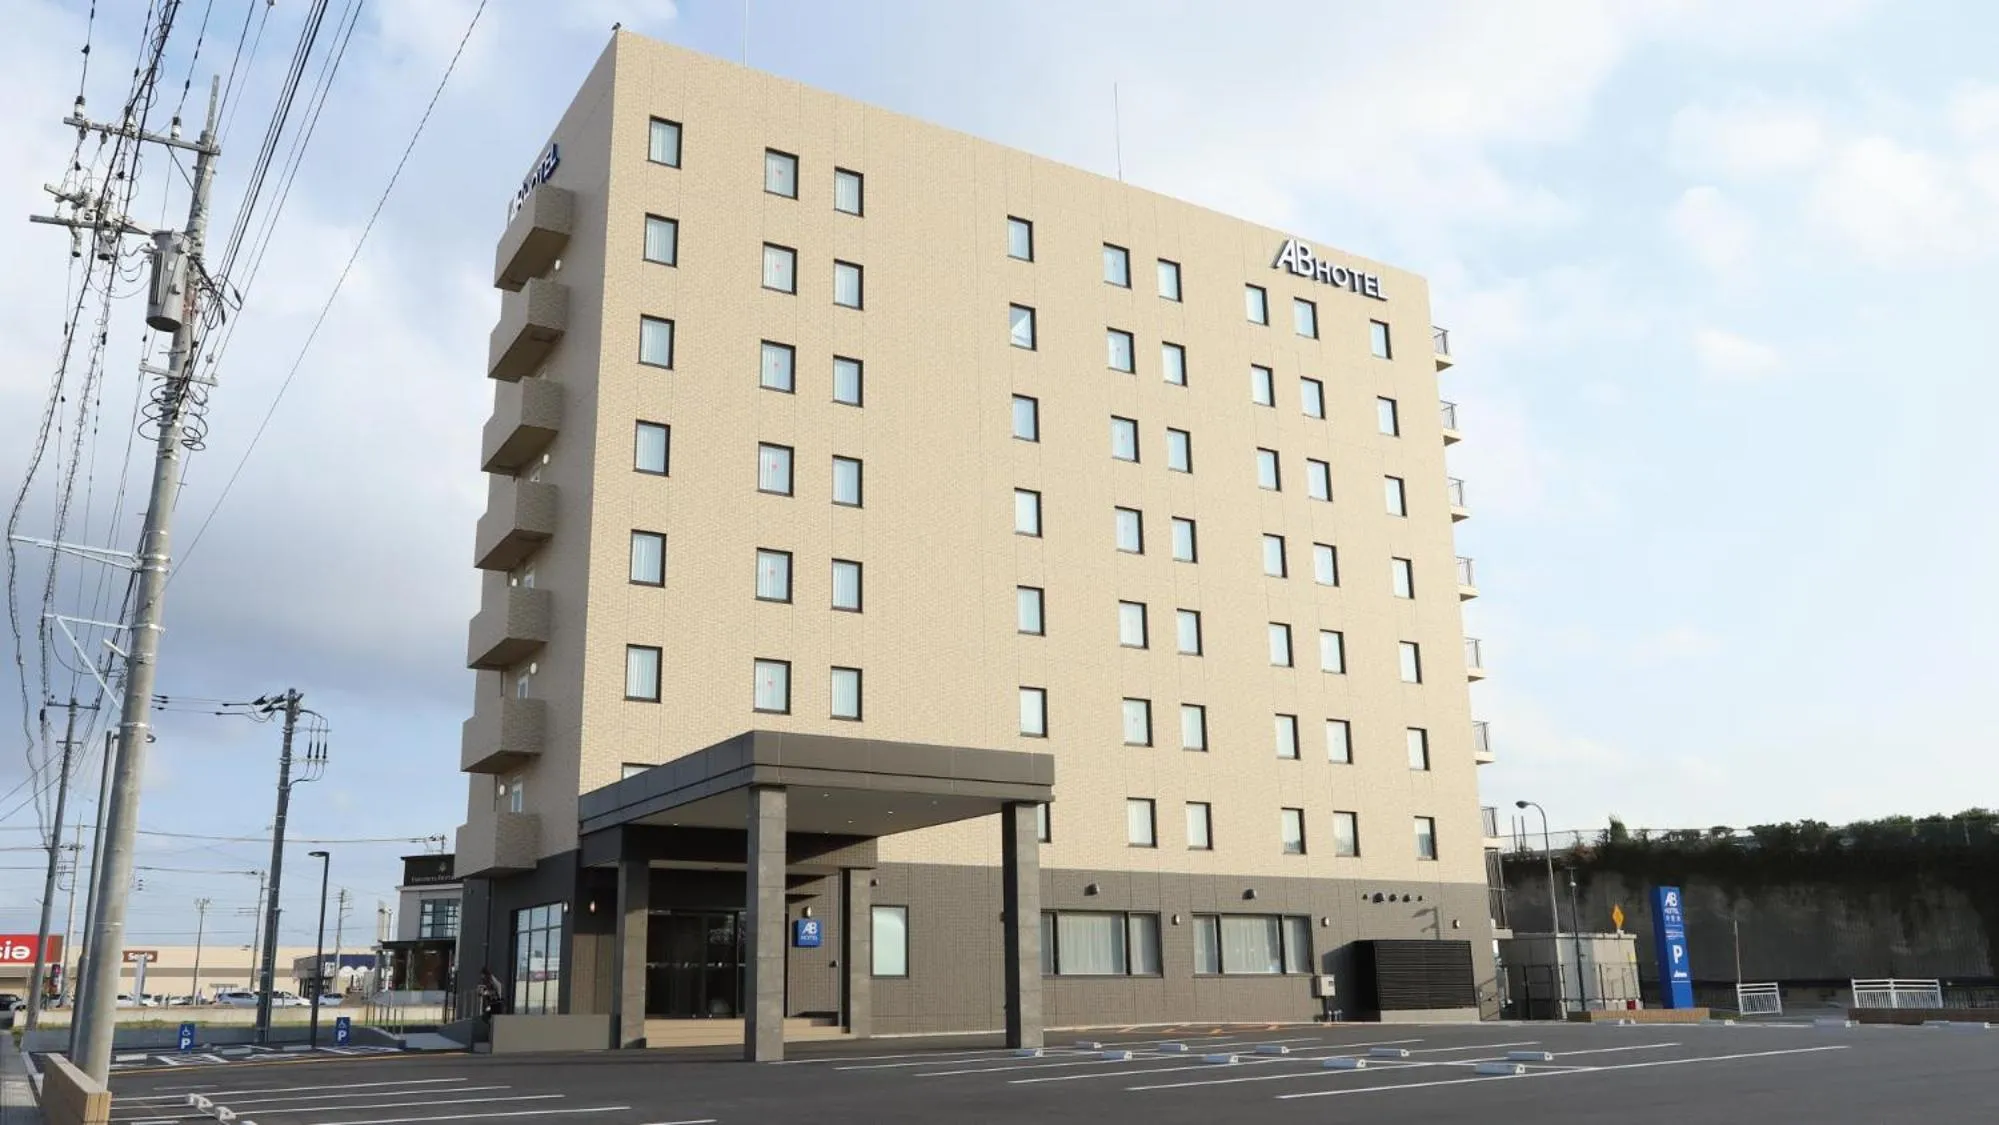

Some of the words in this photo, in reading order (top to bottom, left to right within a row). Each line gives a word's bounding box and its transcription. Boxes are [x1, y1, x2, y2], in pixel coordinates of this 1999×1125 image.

[1664, 891, 1678, 907] AB
[801, 922, 818, 935] AB
[1672, 945, 1684, 965] P
[337, 1030, 347, 1042] P
[180, 1037, 191, 1050] P
